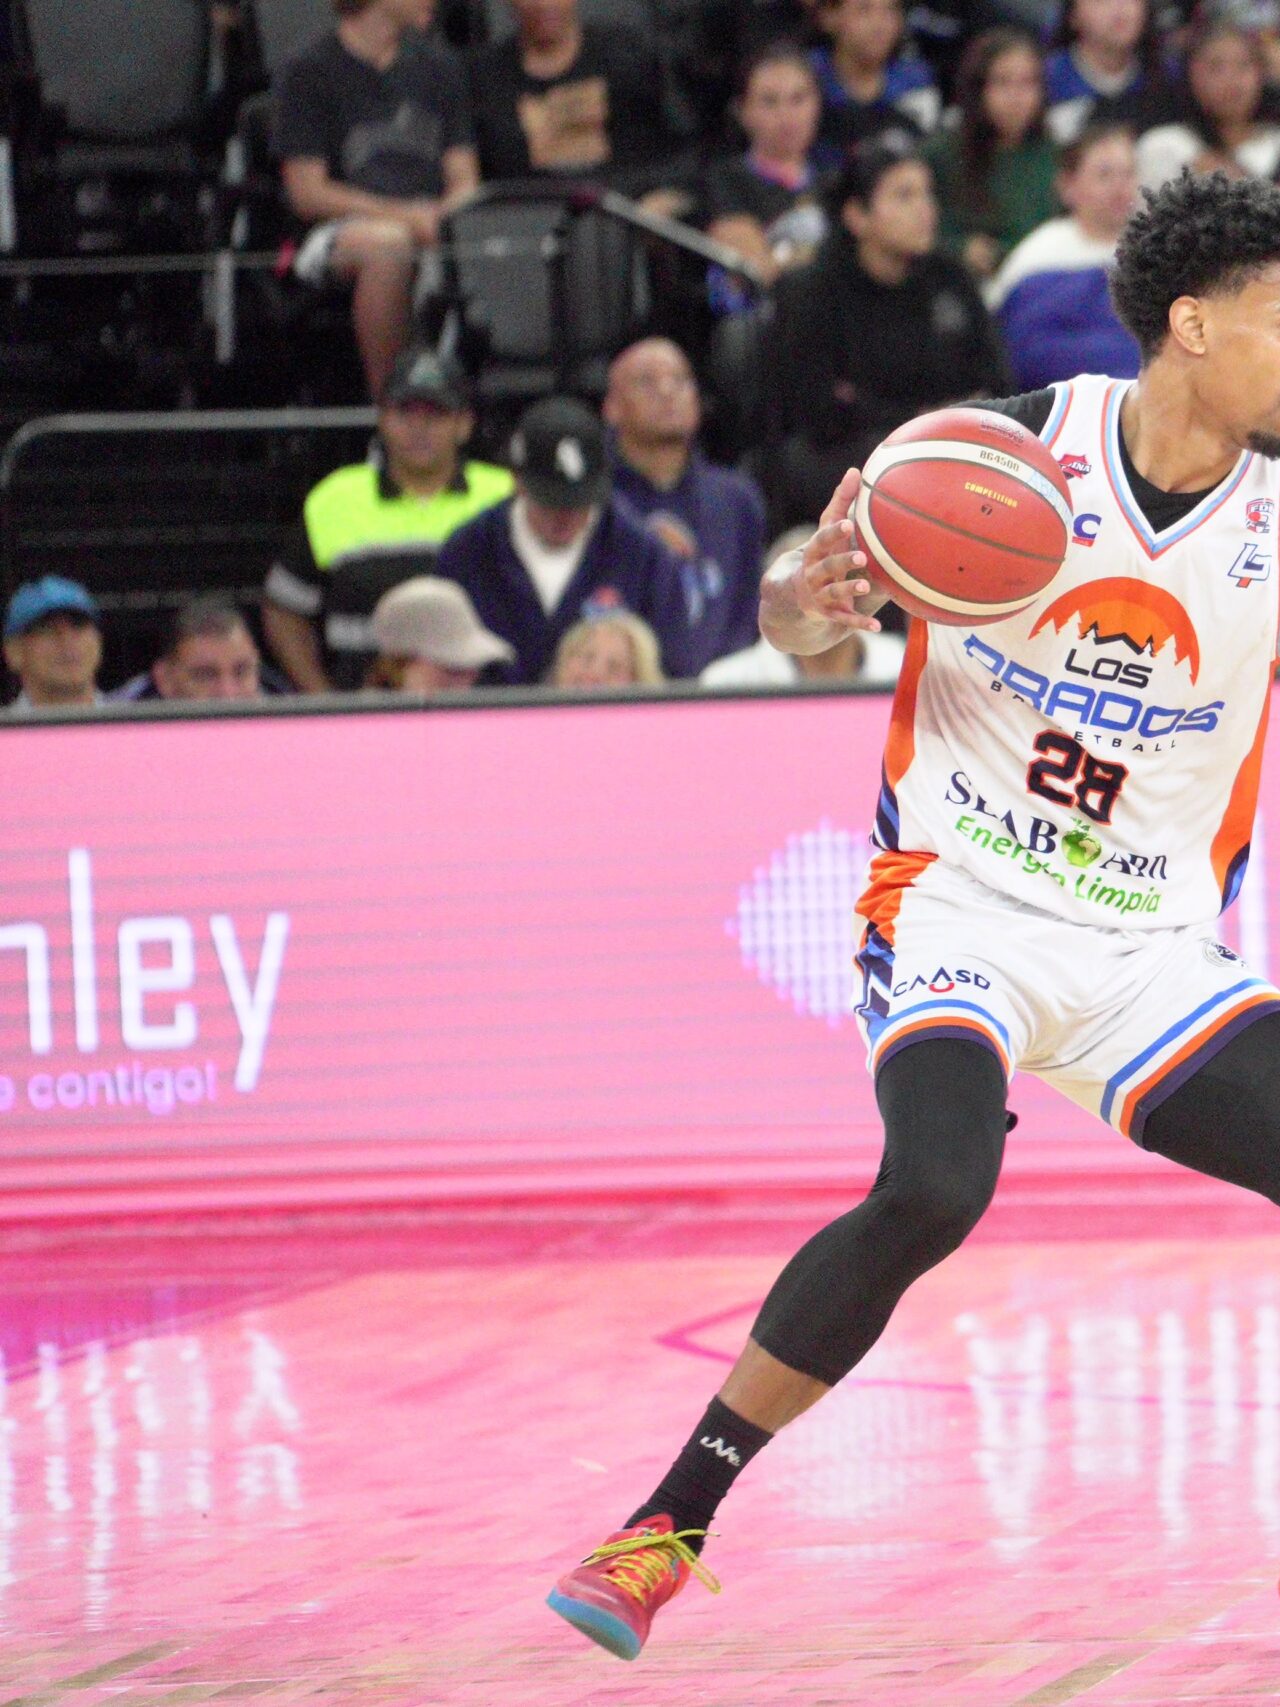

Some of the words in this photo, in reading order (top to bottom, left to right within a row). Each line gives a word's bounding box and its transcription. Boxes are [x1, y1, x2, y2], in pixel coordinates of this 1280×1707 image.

[979, 449, 1020, 472] BG4500
[964, 481, 1018, 508] COMPETITION
[963, 633, 1225, 738] PRADOS
[1064, 648, 1153, 689] LOS
[1026, 728, 1129, 825] 28
[1074, 873, 1162, 914] Limpia
